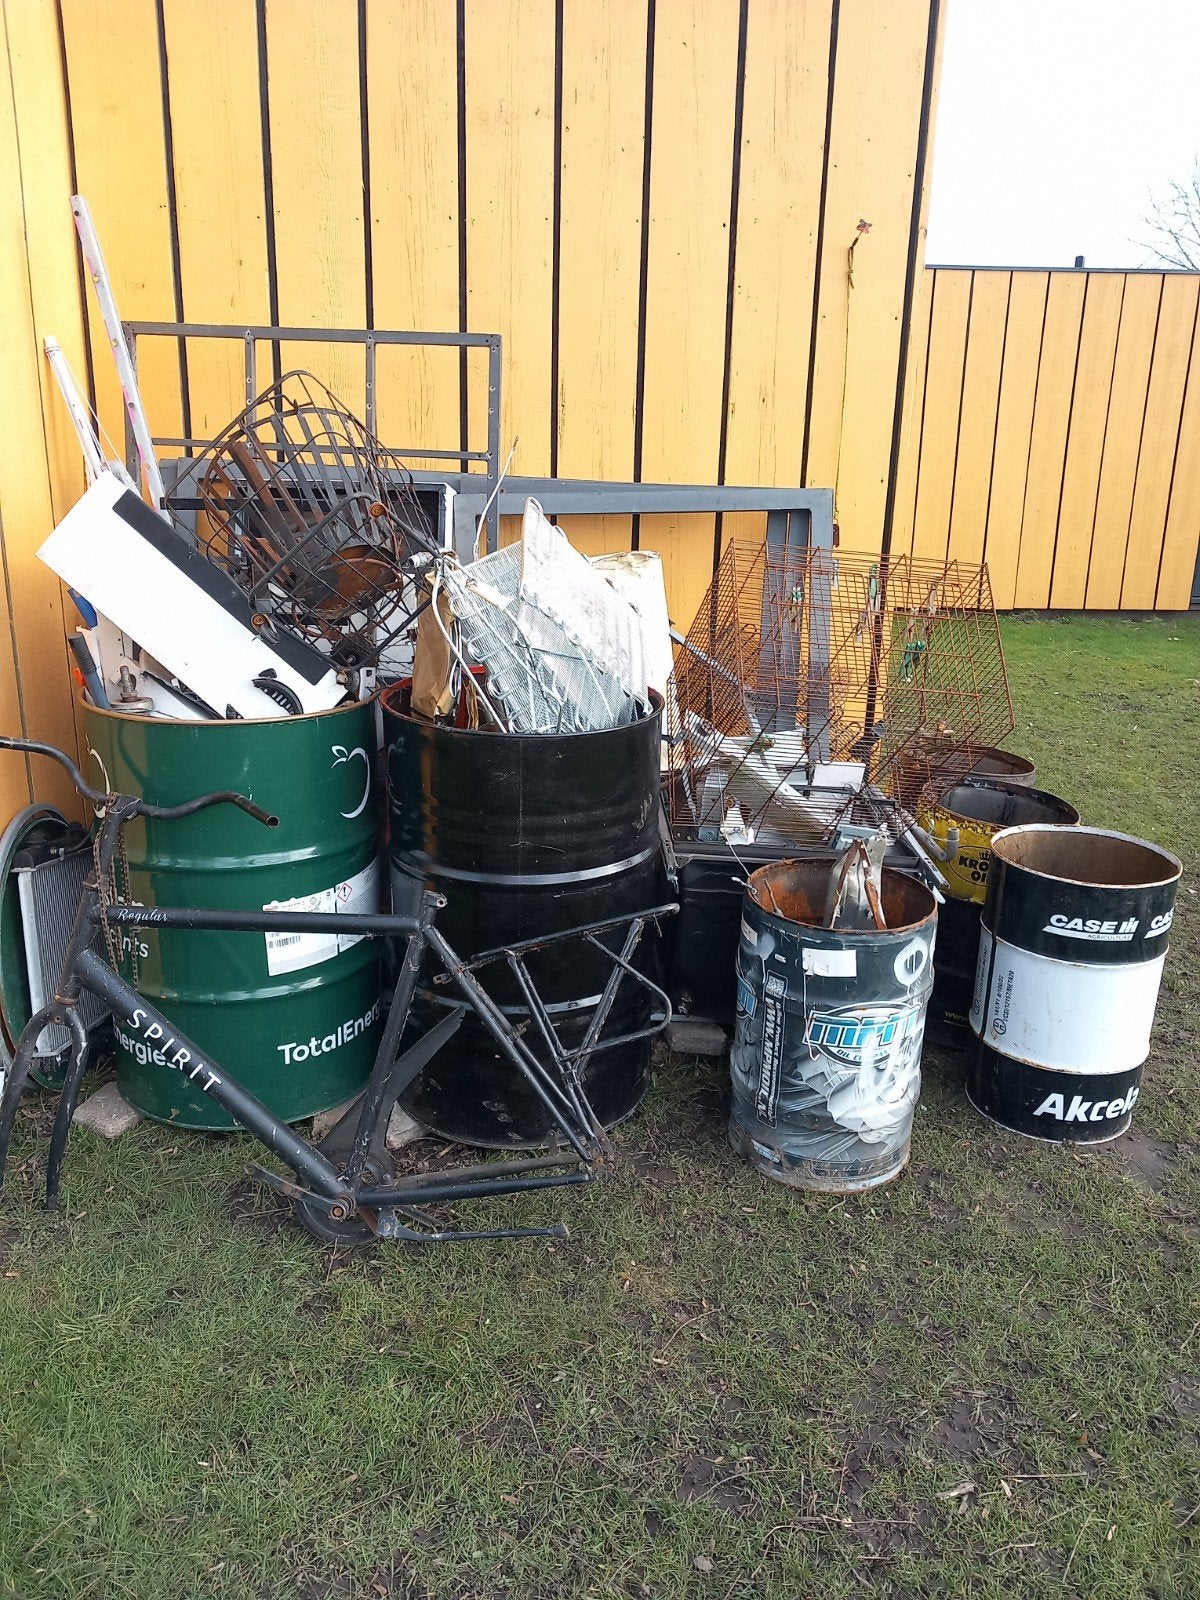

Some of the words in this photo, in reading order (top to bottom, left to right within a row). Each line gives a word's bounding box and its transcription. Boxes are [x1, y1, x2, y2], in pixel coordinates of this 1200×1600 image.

[959, 855, 990, 872] KRO
[117, 908, 168, 925] Regular
[1049, 914, 1118, 933] CASE
[126, 1009, 222, 1092] SPIRIT
